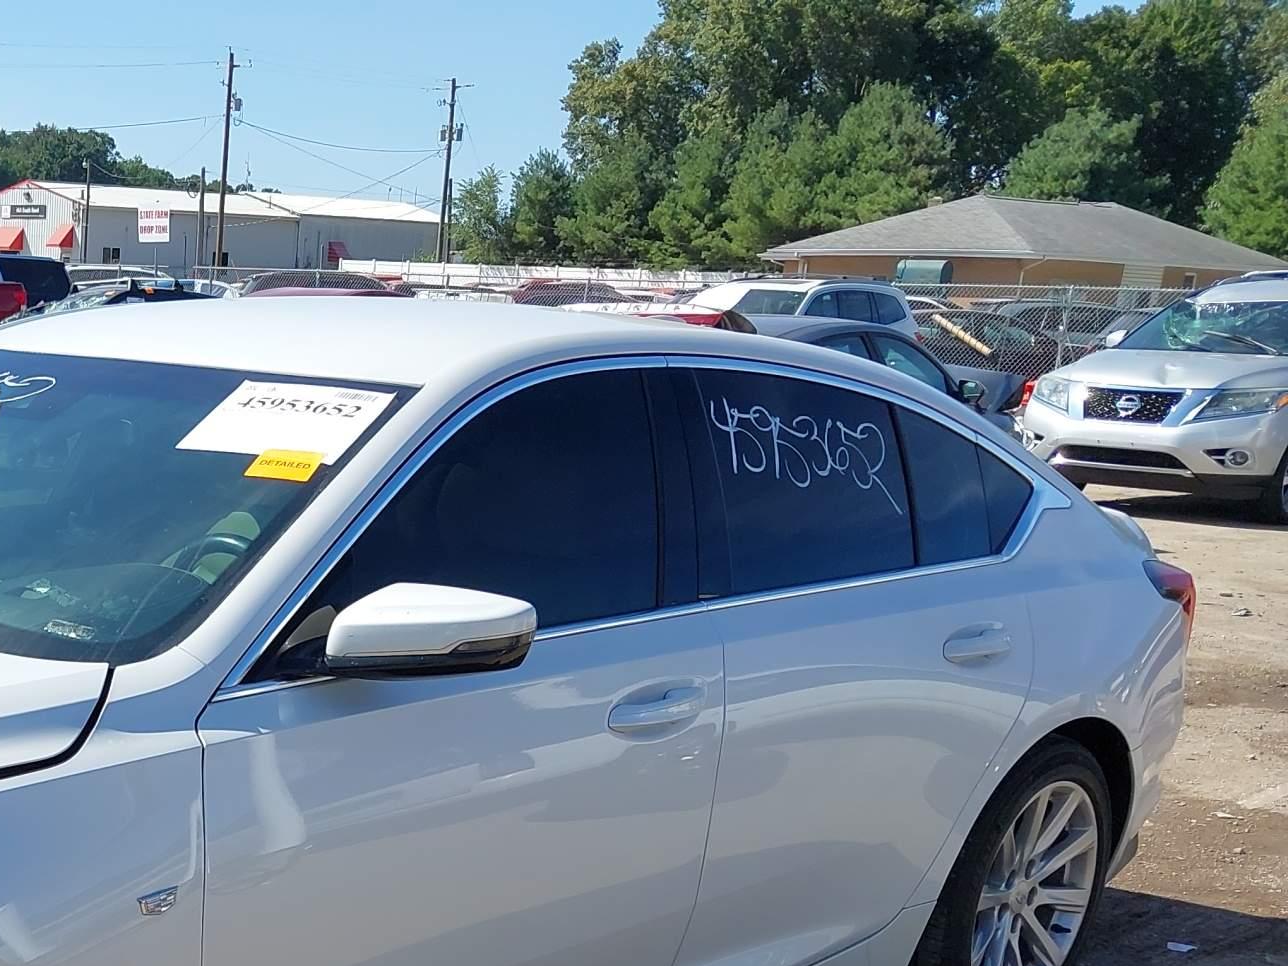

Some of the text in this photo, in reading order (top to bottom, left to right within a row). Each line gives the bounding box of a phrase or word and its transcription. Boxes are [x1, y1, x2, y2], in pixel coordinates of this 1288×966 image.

[139, 210, 168, 219] STATE FARM
[139, 225, 168, 234] DROP ZONE
[236, 395, 363, 418] 45953652
[258, 459, 311, 470] DETAILED
